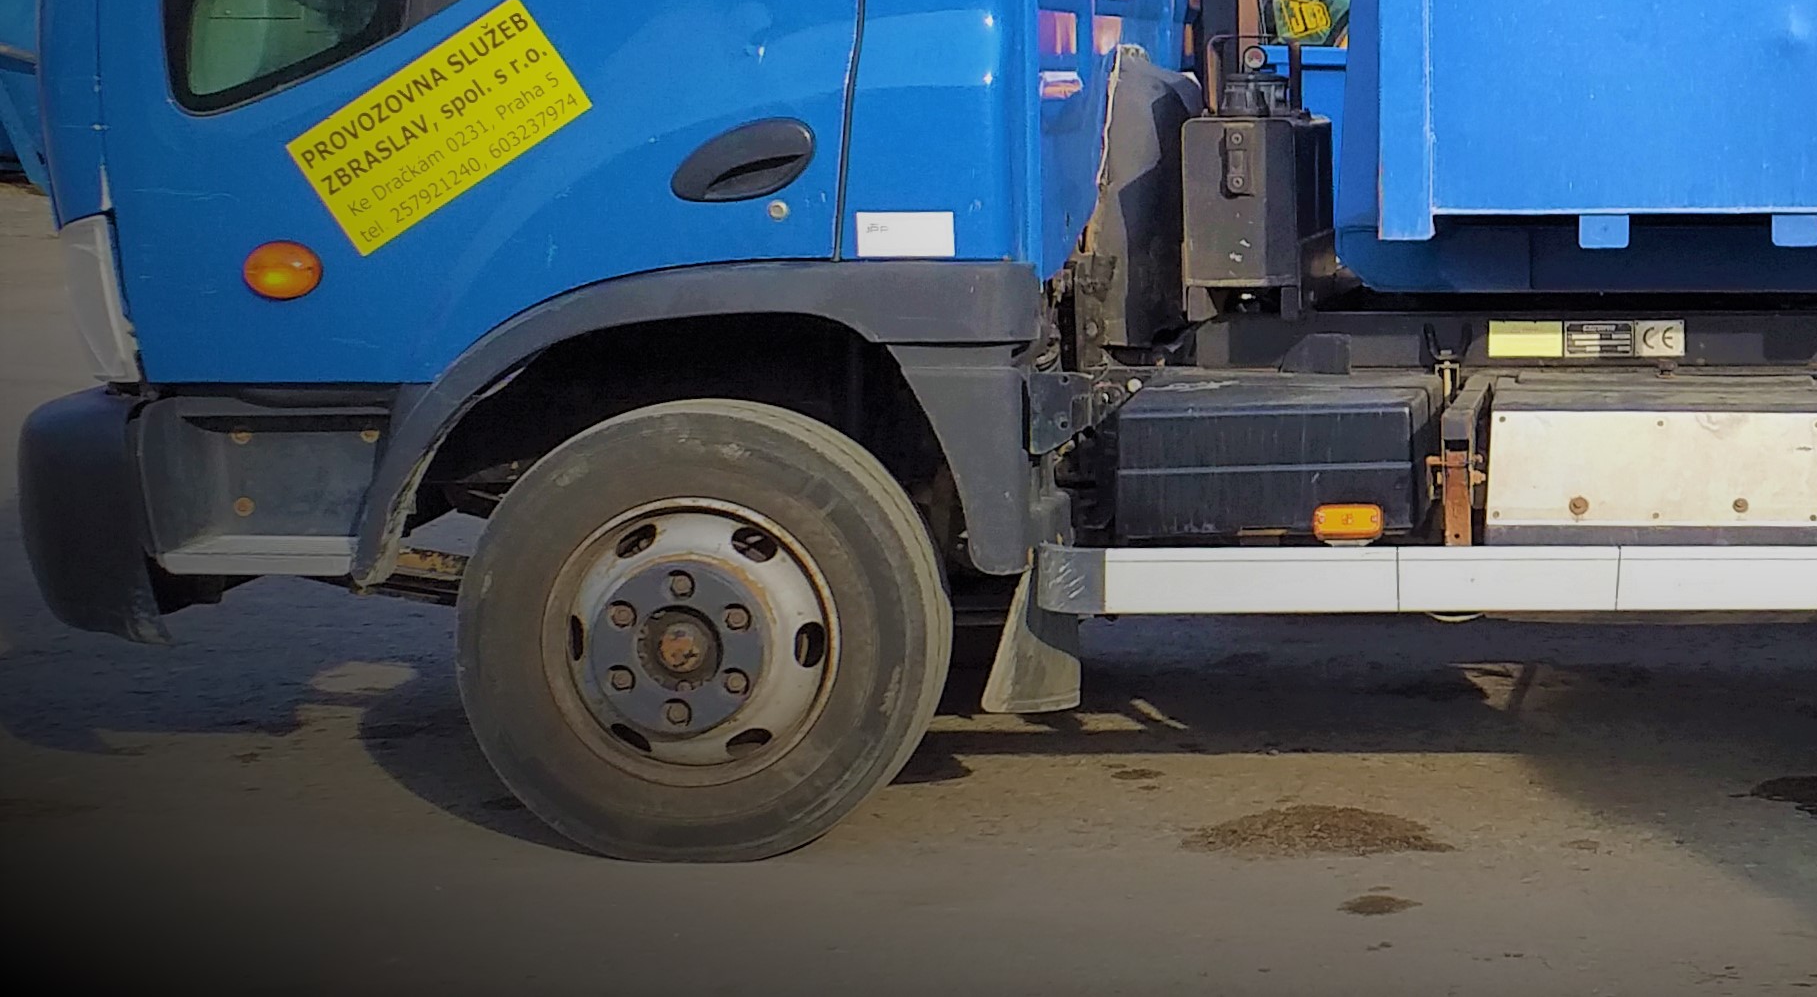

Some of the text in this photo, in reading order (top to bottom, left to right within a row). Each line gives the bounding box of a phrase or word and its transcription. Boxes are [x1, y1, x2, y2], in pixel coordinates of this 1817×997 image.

[1289, 1, 1327, 33] JCB
[301, 12, 529, 169] PROVOZOVNA SLUŽEB
[320, 47, 548, 196] ZBRASLAV, spol. s r.o.
[347, 71, 560, 217] Ke Dračkám 0231, Praha 5
[389, 155, 489, 224] 257921240,
[488, 93, 579, 160] 603237974
